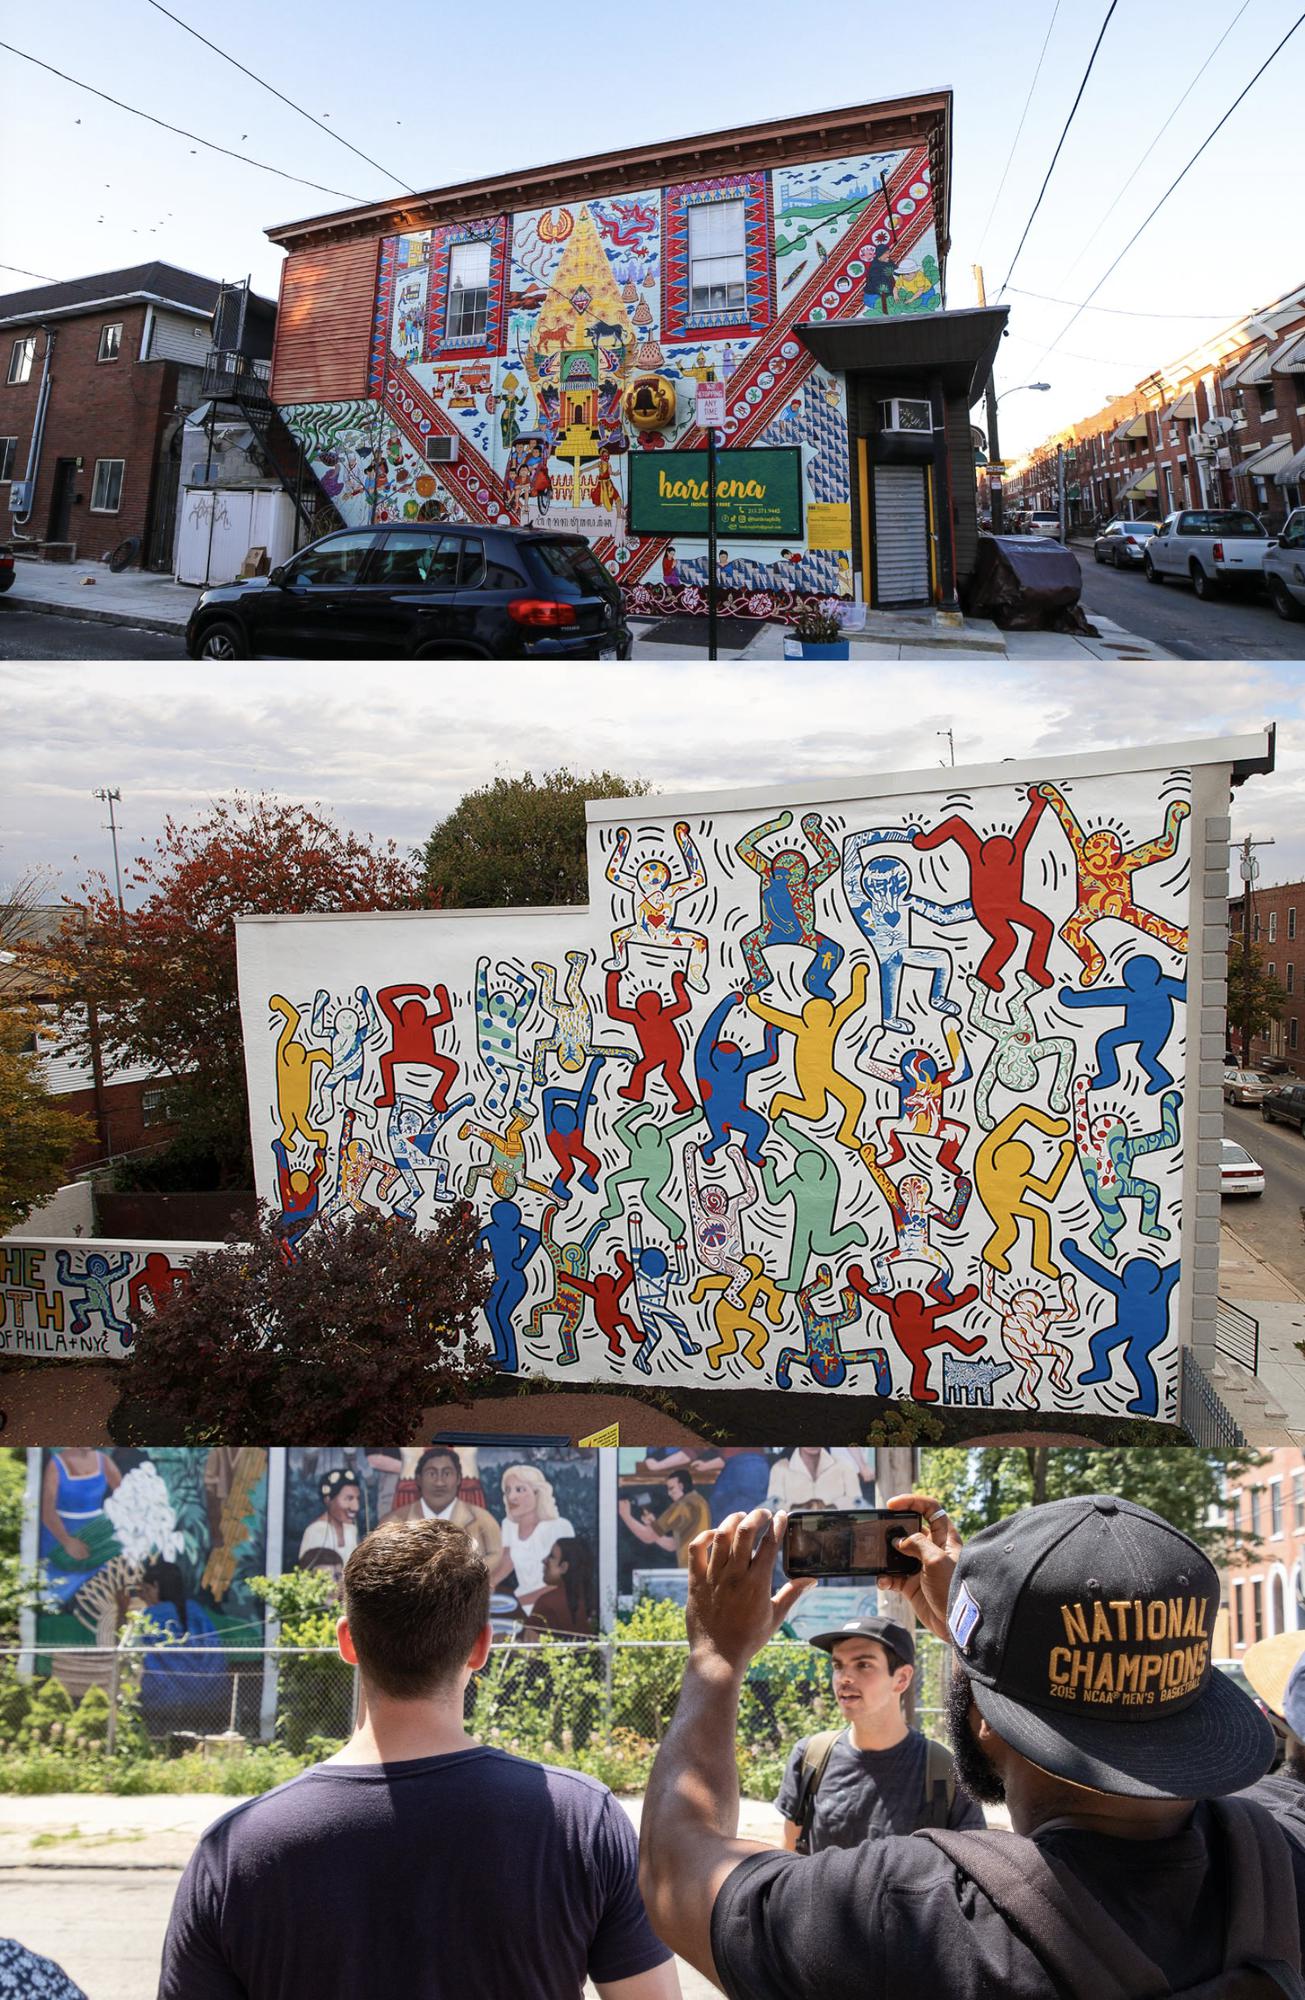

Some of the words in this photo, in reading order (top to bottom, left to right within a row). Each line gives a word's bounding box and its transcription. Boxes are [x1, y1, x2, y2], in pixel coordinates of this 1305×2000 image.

[698, 390, 723, 398] STOPPING
[704, 399, 717, 408] ANY
[704, 408, 718, 416] TIME
[1060, 1597, 1208, 1645] NATIONAL
[1049, 1640, 1209, 1692] CHAMPIONS
[1050, 1684, 1077, 1700] 2015
[1121, 1691, 1155, 1705] MEN'S
